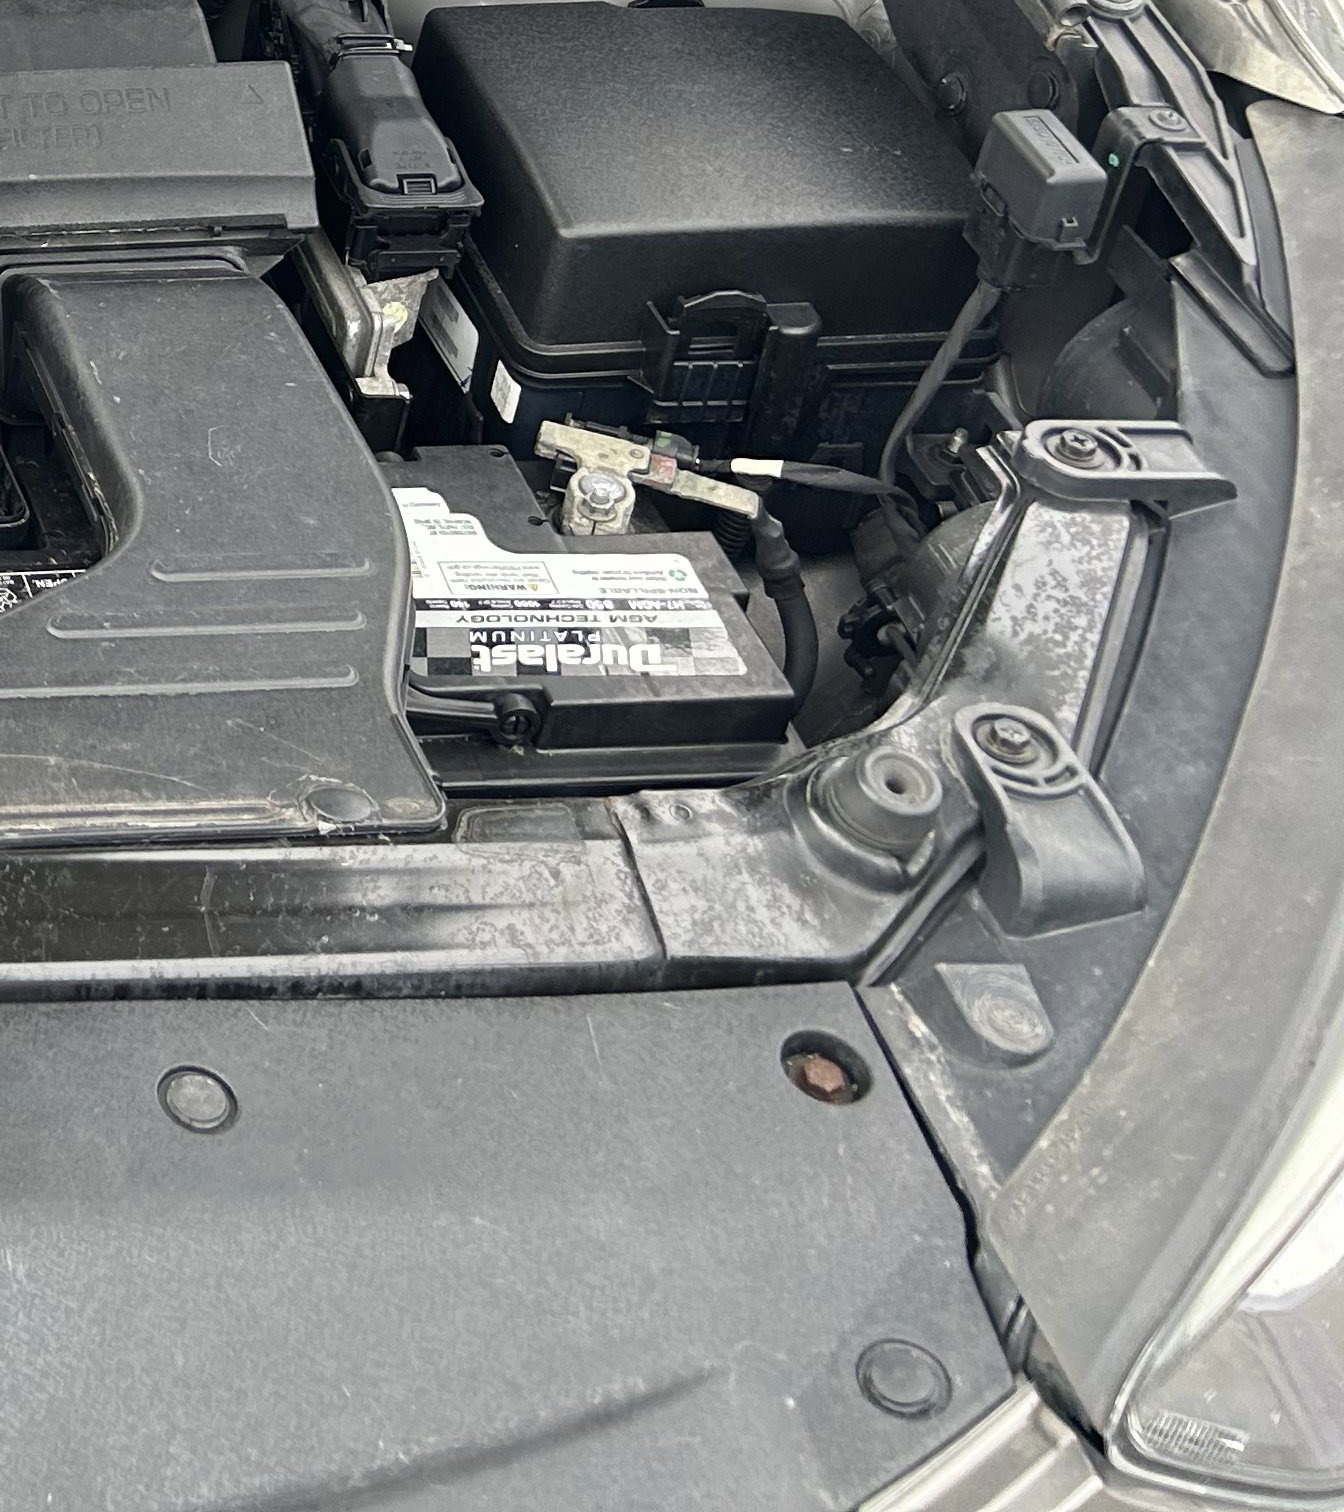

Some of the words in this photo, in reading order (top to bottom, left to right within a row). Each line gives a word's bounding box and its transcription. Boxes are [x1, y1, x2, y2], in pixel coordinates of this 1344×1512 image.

[21, 91, 68, 118] TO
[79, 87, 171, 115] OPEN
[456, 614, 602, 624] TECHNOLOGY
[609, 614, 659, 624] AGM
[469, 630, 601, 643] PLATINUM
[470, 643, 678, 673] Duralast
